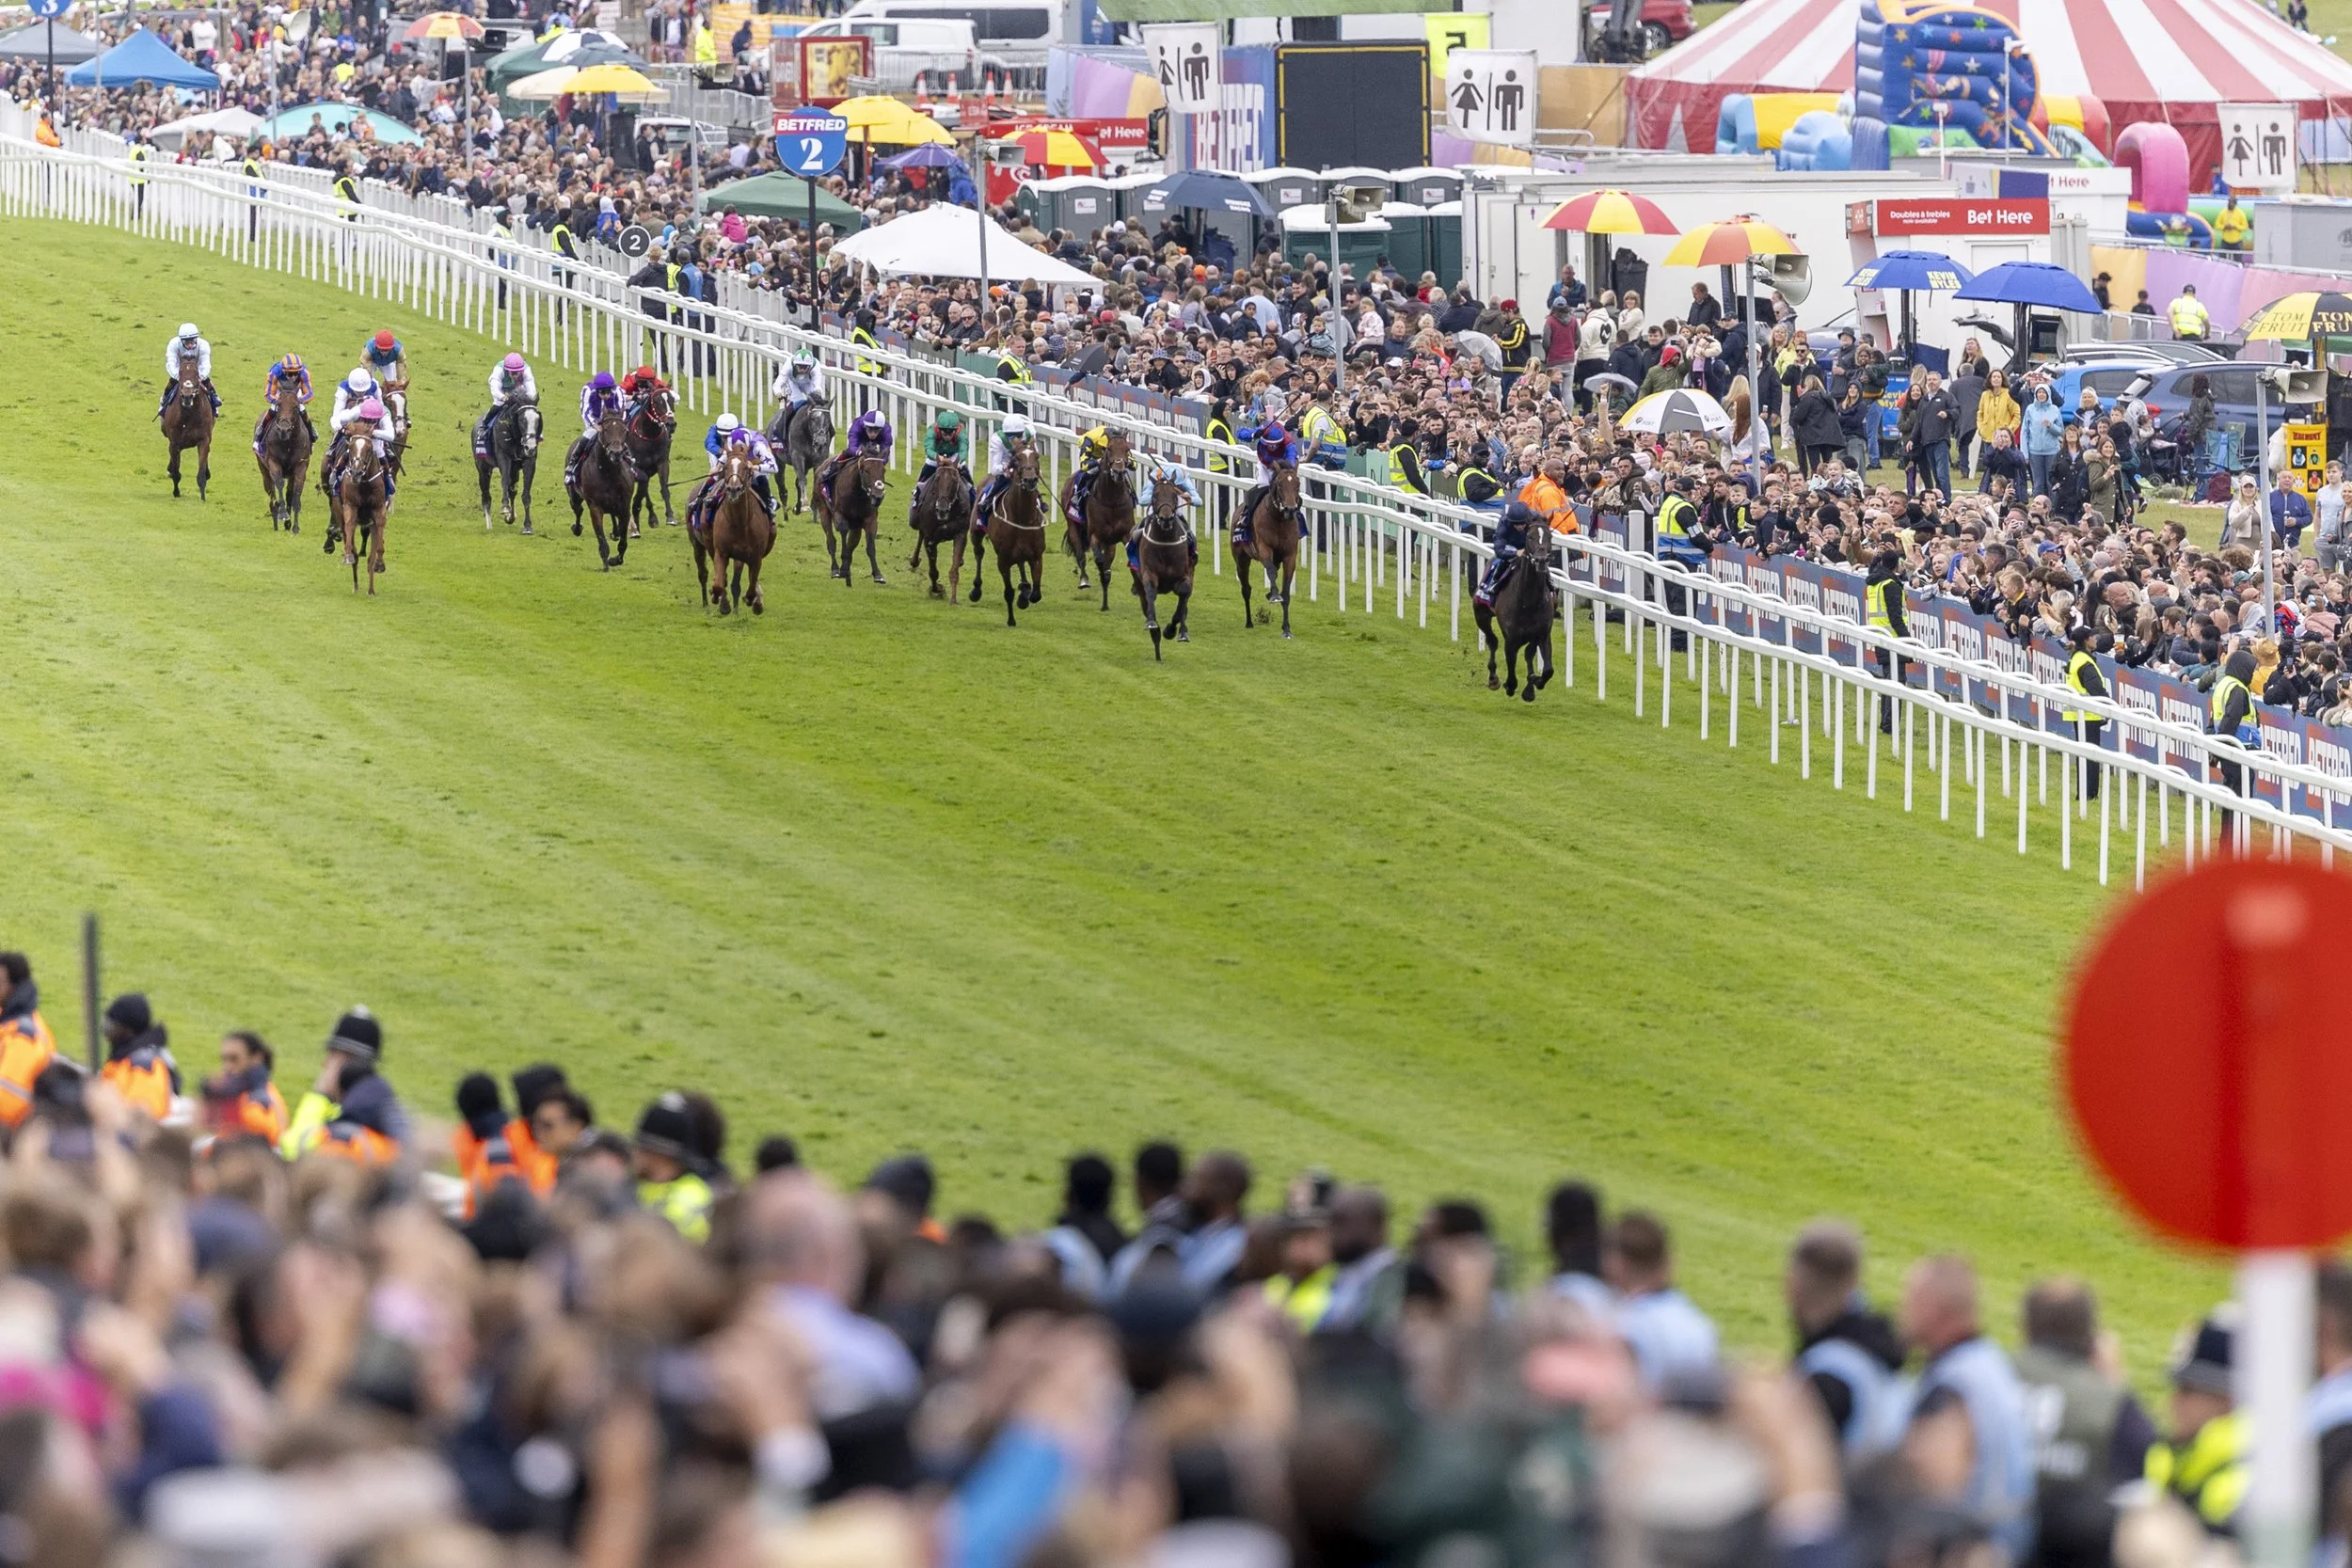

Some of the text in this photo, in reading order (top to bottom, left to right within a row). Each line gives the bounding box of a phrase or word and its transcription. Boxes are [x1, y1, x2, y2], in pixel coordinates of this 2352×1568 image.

[776, 119, 846, 131] BETFRED
[1115, 128, 1145, 138] Here
[800, 137, 823, 169] 2
[2058, 176, 2090, 187] Here
[1890, 210, 1919, 218] Doubles
[1967, 209, 2033, 224] Bet Here
[629, 234, 641, 250] 2
[2272, 311, 2305, 322] TOM
[2258, 322, 2308, 333] FRUIT
